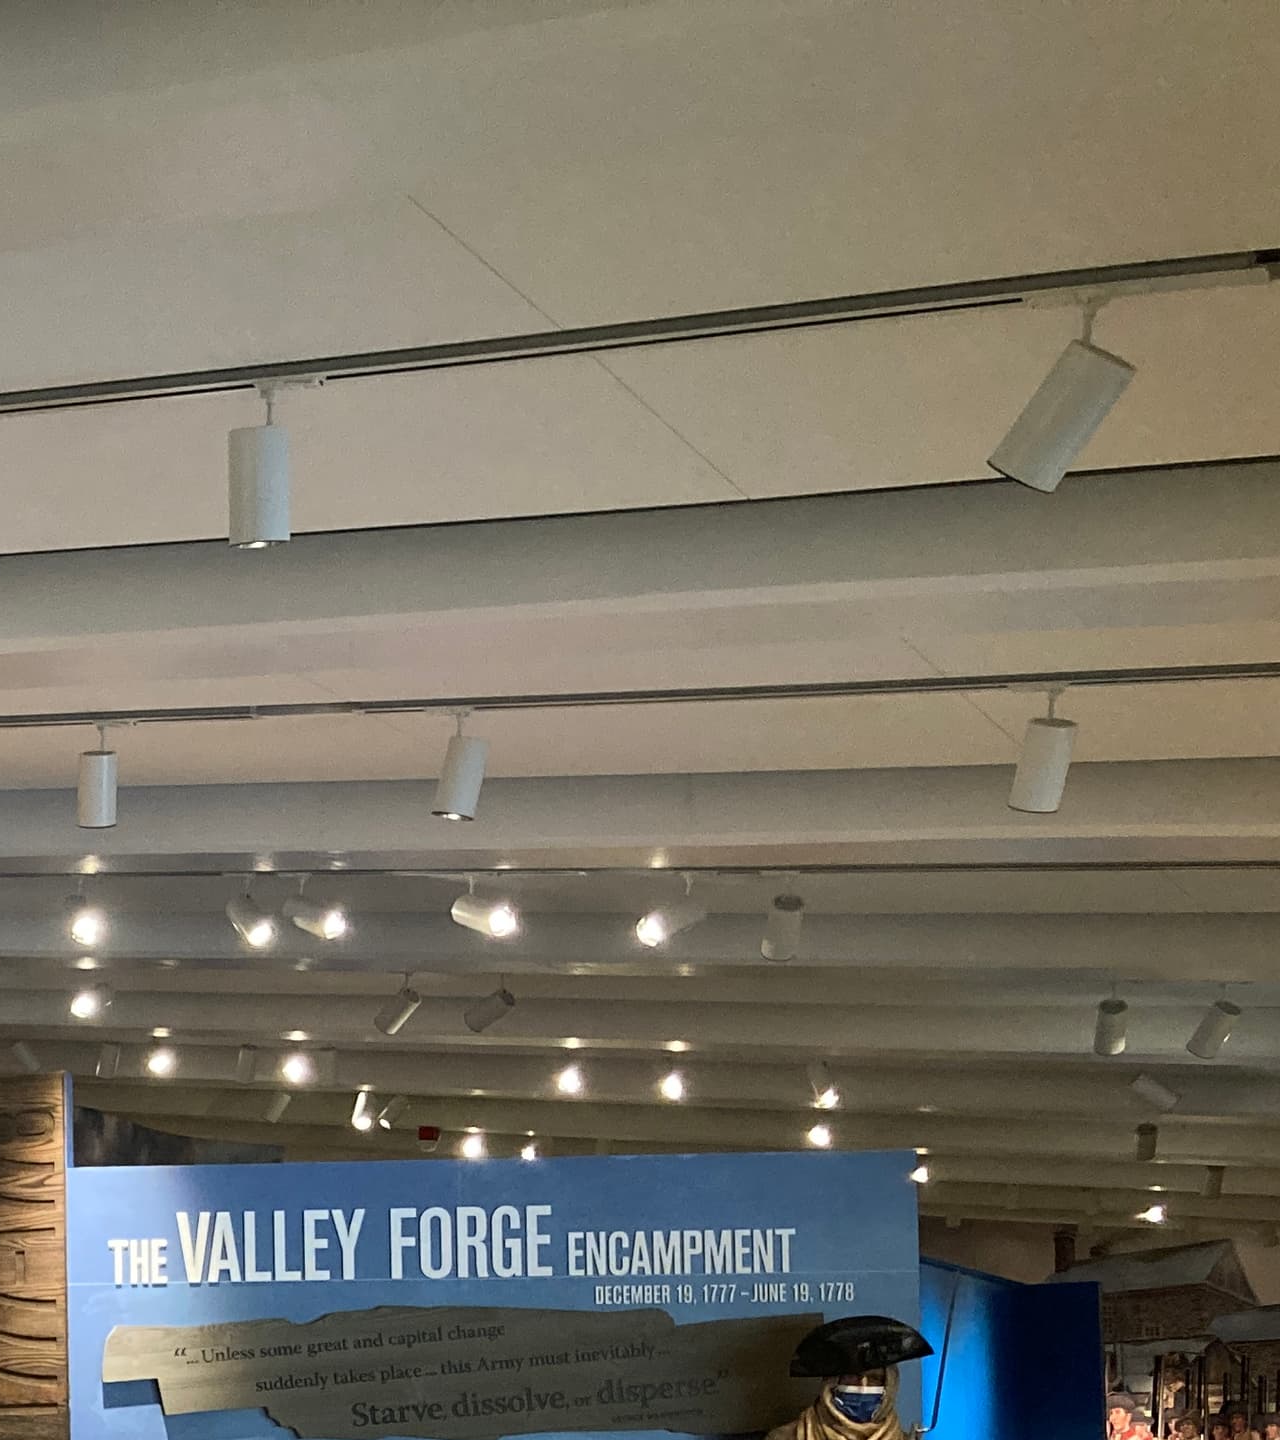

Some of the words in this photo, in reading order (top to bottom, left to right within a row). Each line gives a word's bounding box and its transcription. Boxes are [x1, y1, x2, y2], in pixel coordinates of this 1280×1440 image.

[108, 1239, 168, 1286] THE
[176, 1208, 366, 1284] VALLEY
[390, 1205, 553, 1280] FORGE
[568, 1228, 796, 1277] ENCAMPMENT
[595, 1284, 670, 1304] DECEMBER
[676, 1284, 696, 1305] 19,
[703, 1283, 736, 1303] 1777
[793, 1282, 814, 1303] 19,
[819, 1282, 854, 1301] 1778
[259, 1345, 302, 1359] some
[307, 1340, 349, 1358] great
[353, 1333, 383, 1350] and
[388, 1326, 441, 1348] capital
[447, 1323, 505, 1342] change
[255, 1371, 328, 1392] suddenly
[333, 1369, 375, 1385] takes
[440, 1358, 472, 1375] this
[477, 1355, 524, 1374] Army
[529, 1350, 571, 1367] must
[351, 1400, 448, 1427] Starve,
[452, 1387, 570, 1418] dissolve,
[574, 1395, 592, 1408] or
